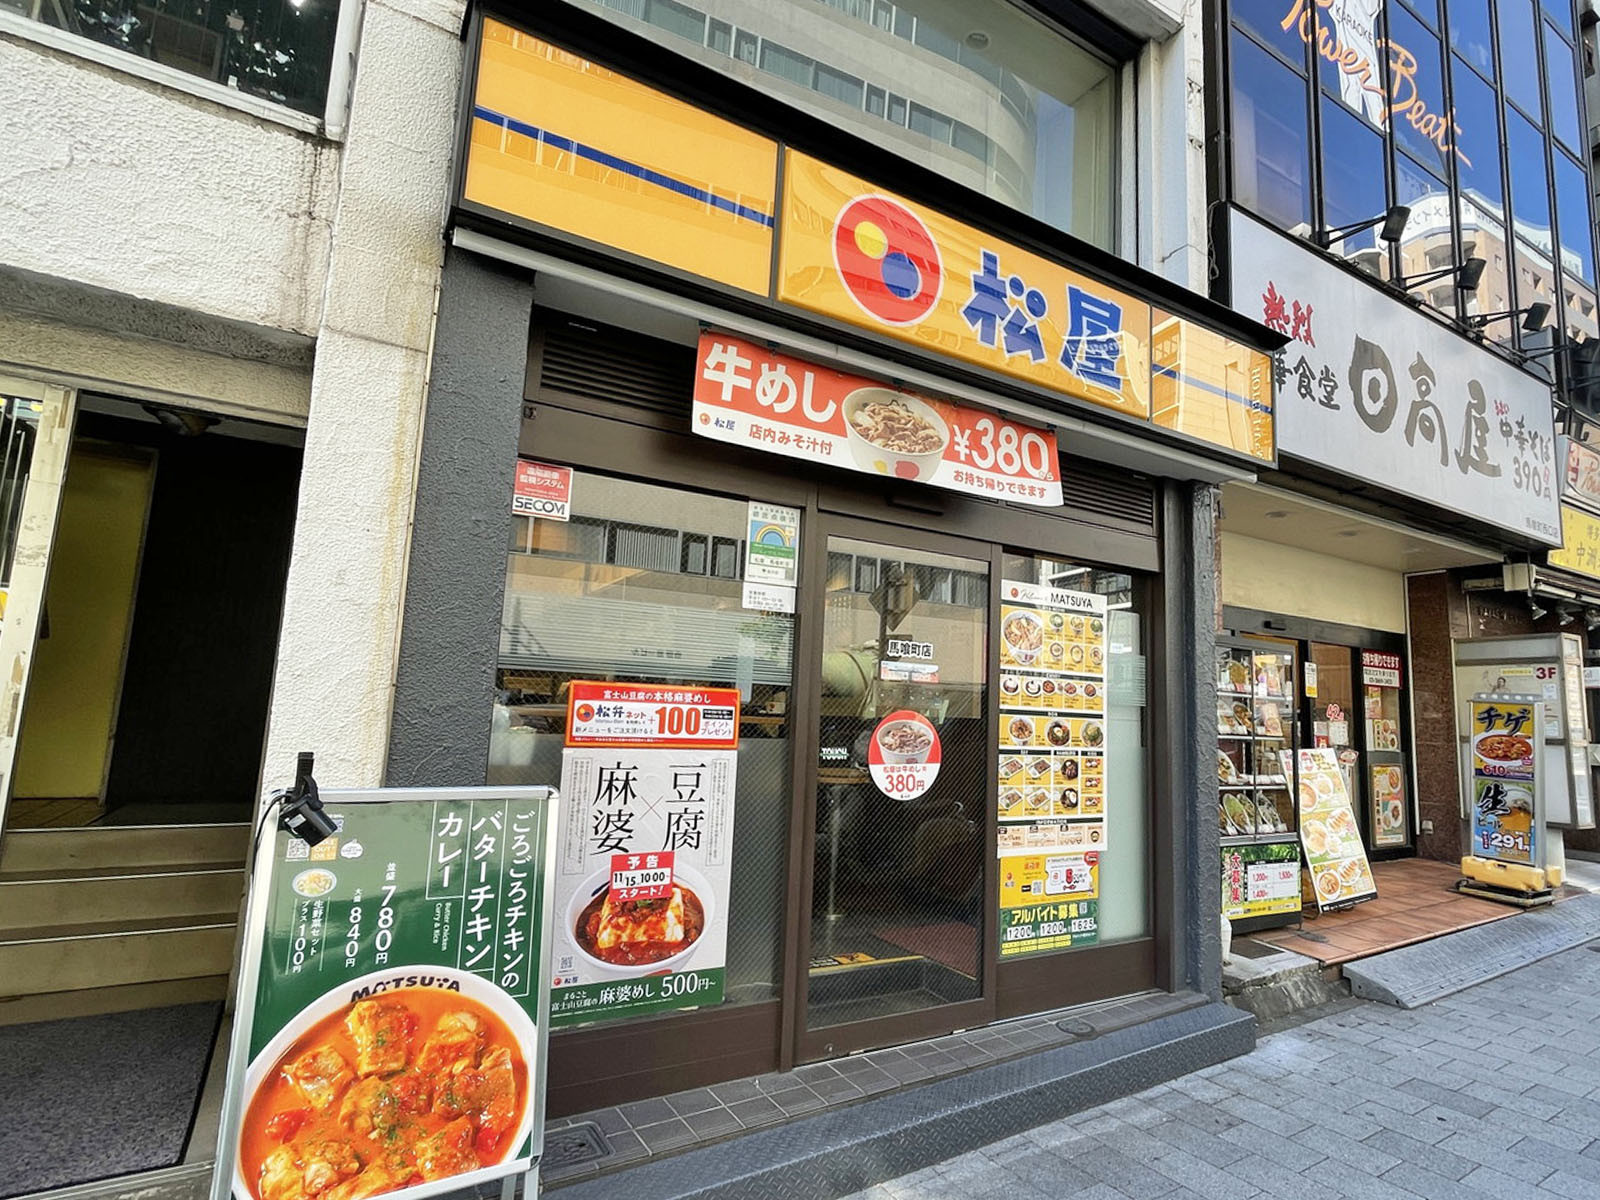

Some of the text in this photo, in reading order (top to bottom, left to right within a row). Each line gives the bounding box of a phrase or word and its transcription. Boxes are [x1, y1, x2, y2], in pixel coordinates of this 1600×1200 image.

[1335, 4, 1374, 46] KARAOKE
[960, 247, 1124, 392] 松屋
[1262, 281, 1316, 348] 熱烈
[702, 342, 837, 423] 牛めし
[1348, 333, 1502, 478] 日高屋
[714, 416, 736, 433] 松屋
[748, 423, 834, 457] 店内みそ汁付
[953, 470, 1047, 499] お持ち帰りできます
[515, 497, 566, 515] SECOM
[1050, 592, 1093, 609] MATSUYA
[888, 640, 932, 657] 馬喰町店
[1535, 667, 1556, 680] 3F
[603, 690, 711, 704] 富士山豆腐の本格麻婆めし
[701, 728, 732, 736] プレゼント
[1477, 706, 1531, 736] チゲ
[884, 774, 925, 793] 380円
[1477, 782, 1511, 816] 生
[590, 761, 639, 856] 麻婆
[662, 763, 707, 850] 豆腐
[437, 812, 463, 888] カレー
[627, 855, 659, 869] 予告
[465, 810, 503, 968] バターチキン
[501, 810, 535, 989] ごろごろチキンの
[310, 900, 325, 956] 生野菜セット
[375, 885, 397, 964] 780円
[433, 902, 442, 921] Curry
[1011, 903, 1078, 925] アルバイト募集
[345, 906, 362, 968] 840円
[551, 997, 598, 1012] 富士山豆腐の
[599, 984, 656, 1005] 麻婆めし
